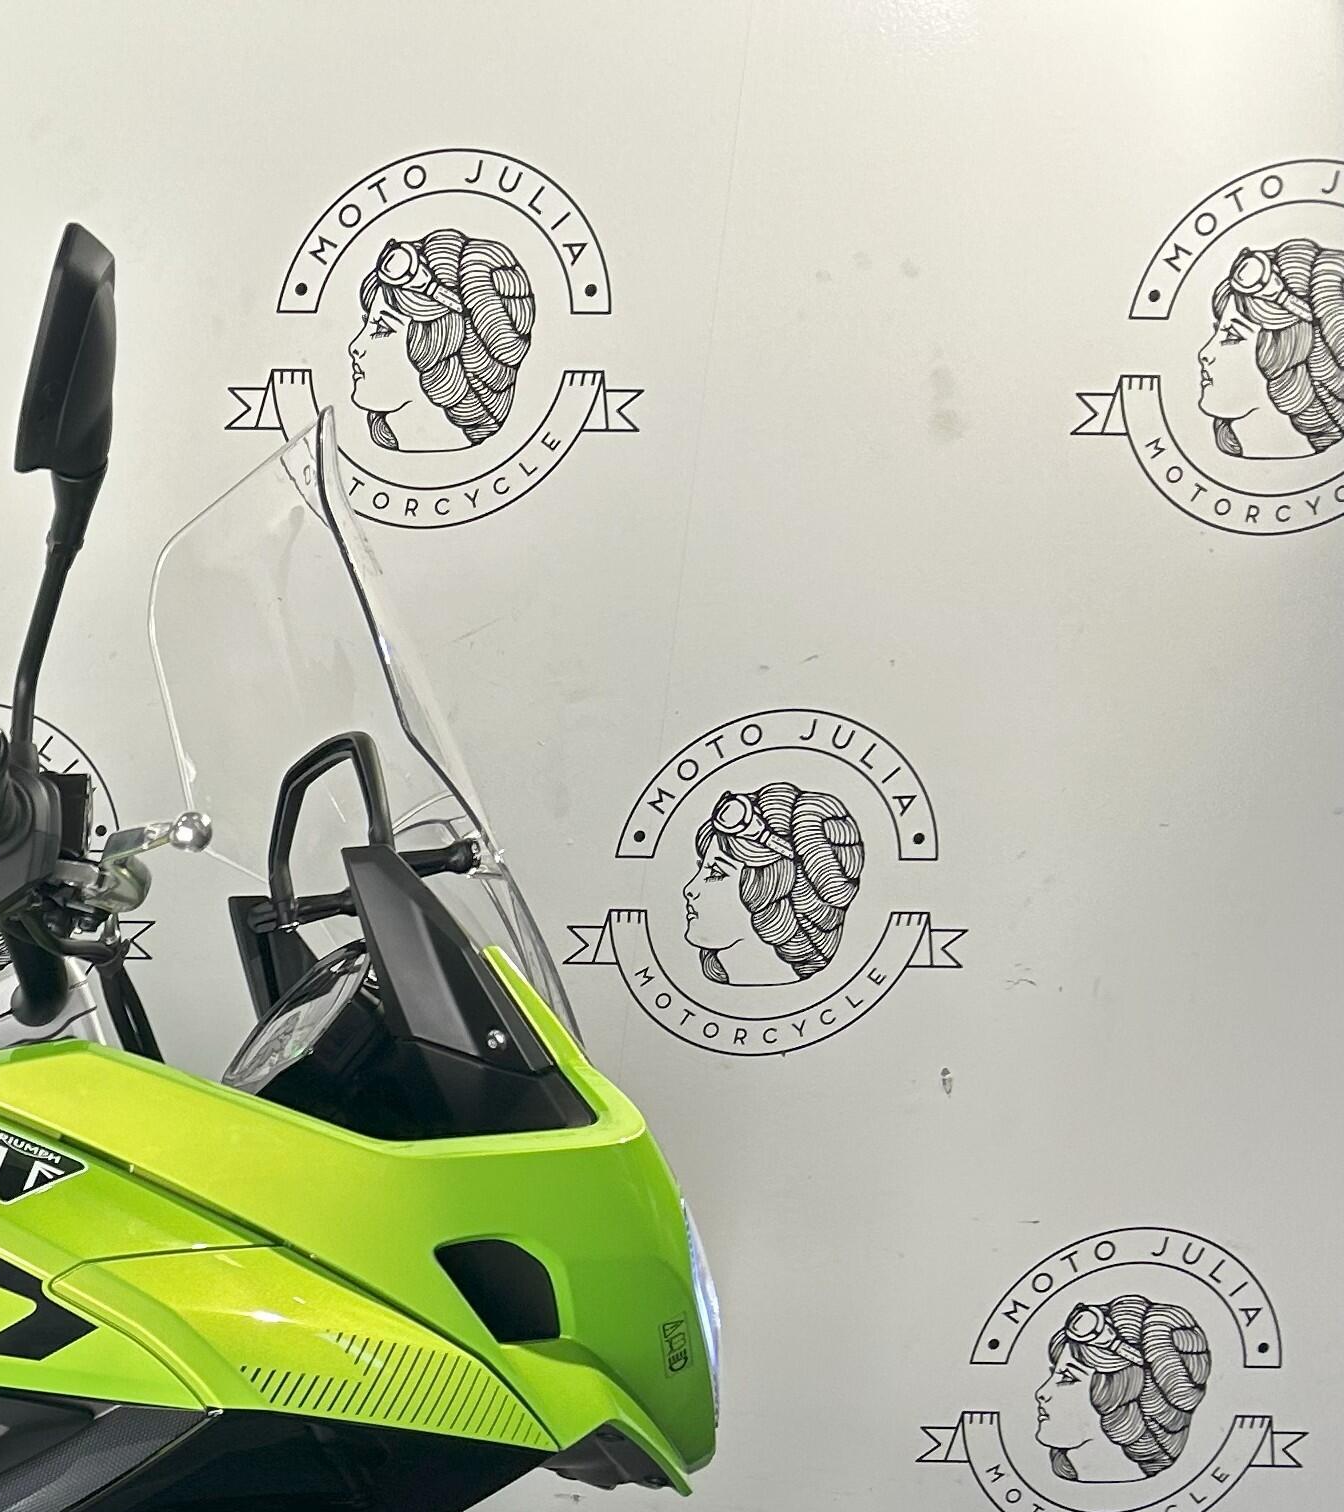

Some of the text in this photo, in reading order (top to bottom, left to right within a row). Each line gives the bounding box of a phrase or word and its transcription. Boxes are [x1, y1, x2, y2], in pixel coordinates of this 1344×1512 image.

[309, 159, 588, 267] MOTO JULIA
[1163, 174, 1283, 273] MOTO
[348, 431, 561, 517] TORCYCLE
[1144, 437, 1344, 524] MOTORCYC
[647, 718, 918, 817] MOTO JULIA
[634, 966, 887, 1046] MOTORCYCLE
[1002, 1236, 1262, 1327] MOTO JULIA
